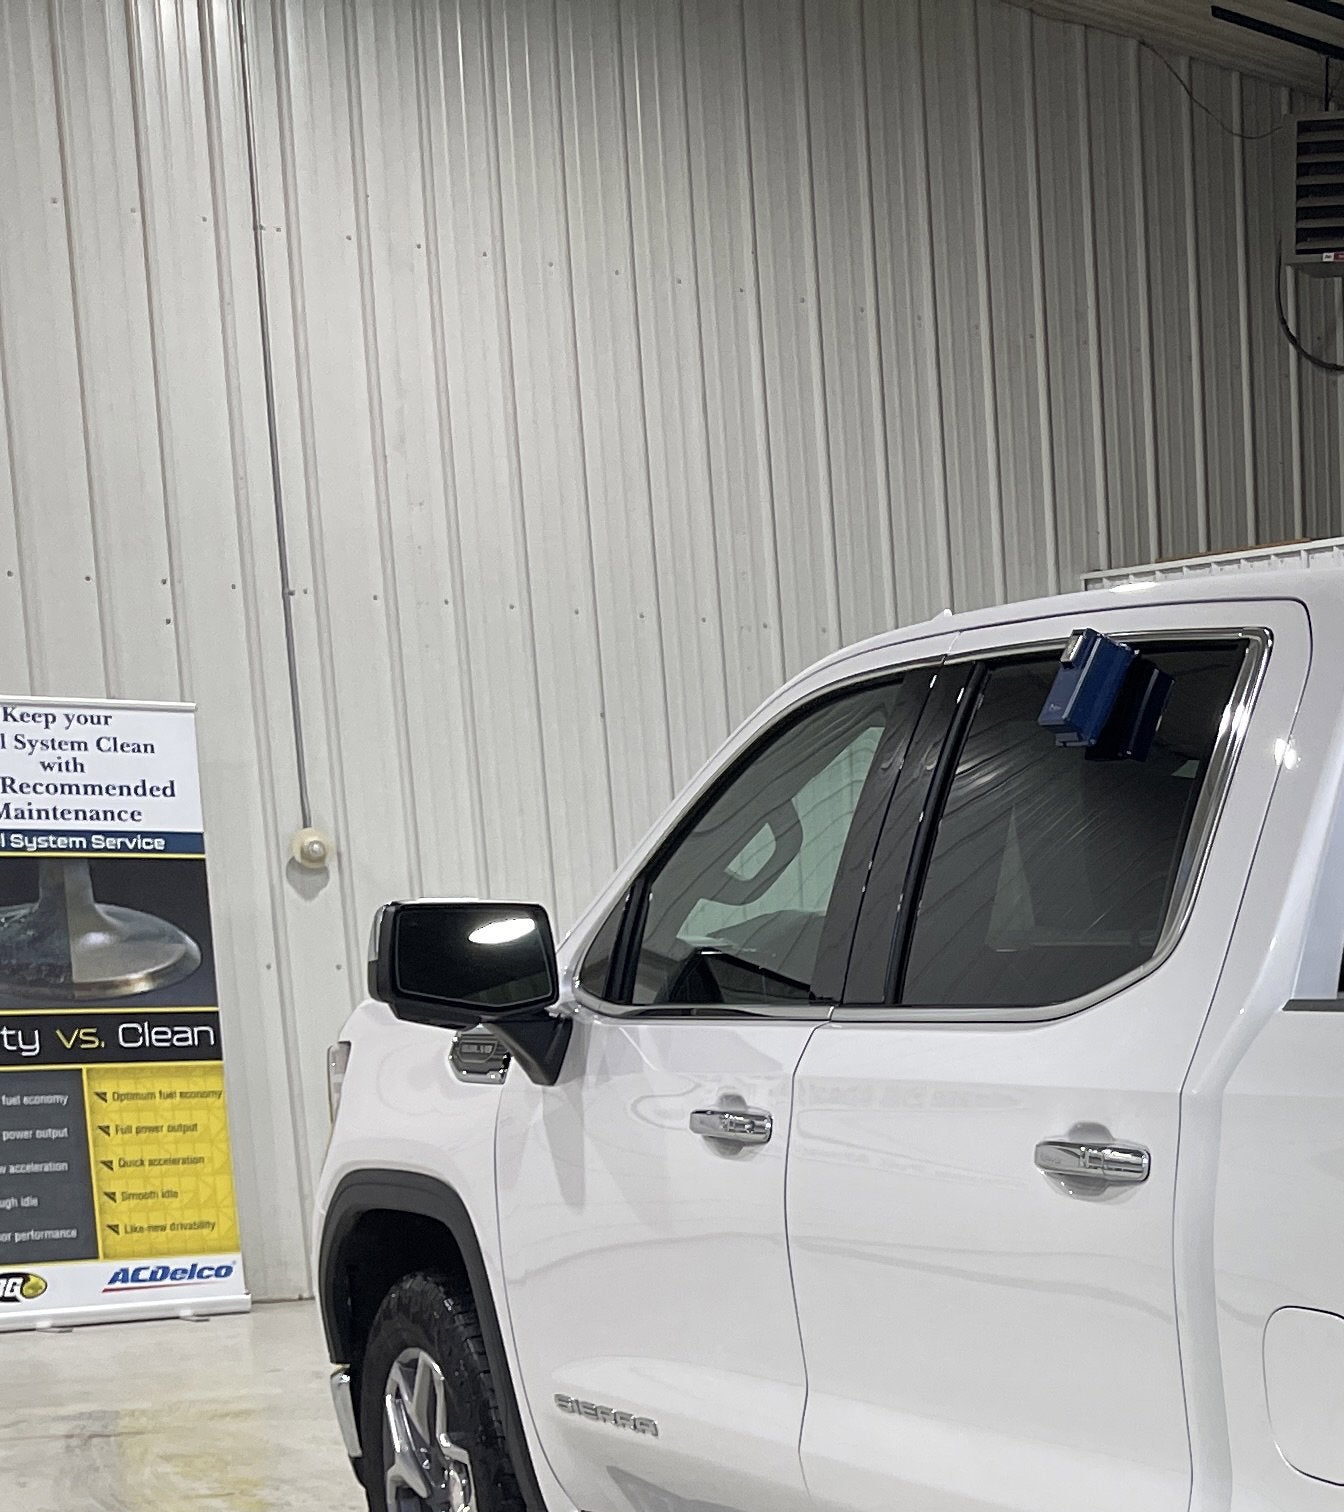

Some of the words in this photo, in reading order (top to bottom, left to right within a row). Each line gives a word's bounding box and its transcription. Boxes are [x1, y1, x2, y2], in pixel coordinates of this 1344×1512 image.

[2, 706, 57, 730] Keep
[63, 712, 113, 731] your
[14, 733, 89, 756] System
[96, 735, 155, 755] Clean
[39, 755, 86, 773] with
[0, 776, 176, 798] Recommended
[10, 833, 88, 852] System
[90, 834, 166, 850] Service
[56, 1027, 105, 1049] vs.
[117, 1022, 215, 1049] Clean
[2, 1094, 21, 1106] fuel
[23, 1094, 69, 1107] economy
[2, 1130, 33, 1142] power
[35, 1127, 69, 1140] output
[14, 1228, 78, 1243] performance
[108, 1263, 234, 1285] ACDelco
[554, 1393, 659, 1437] SIERRA
